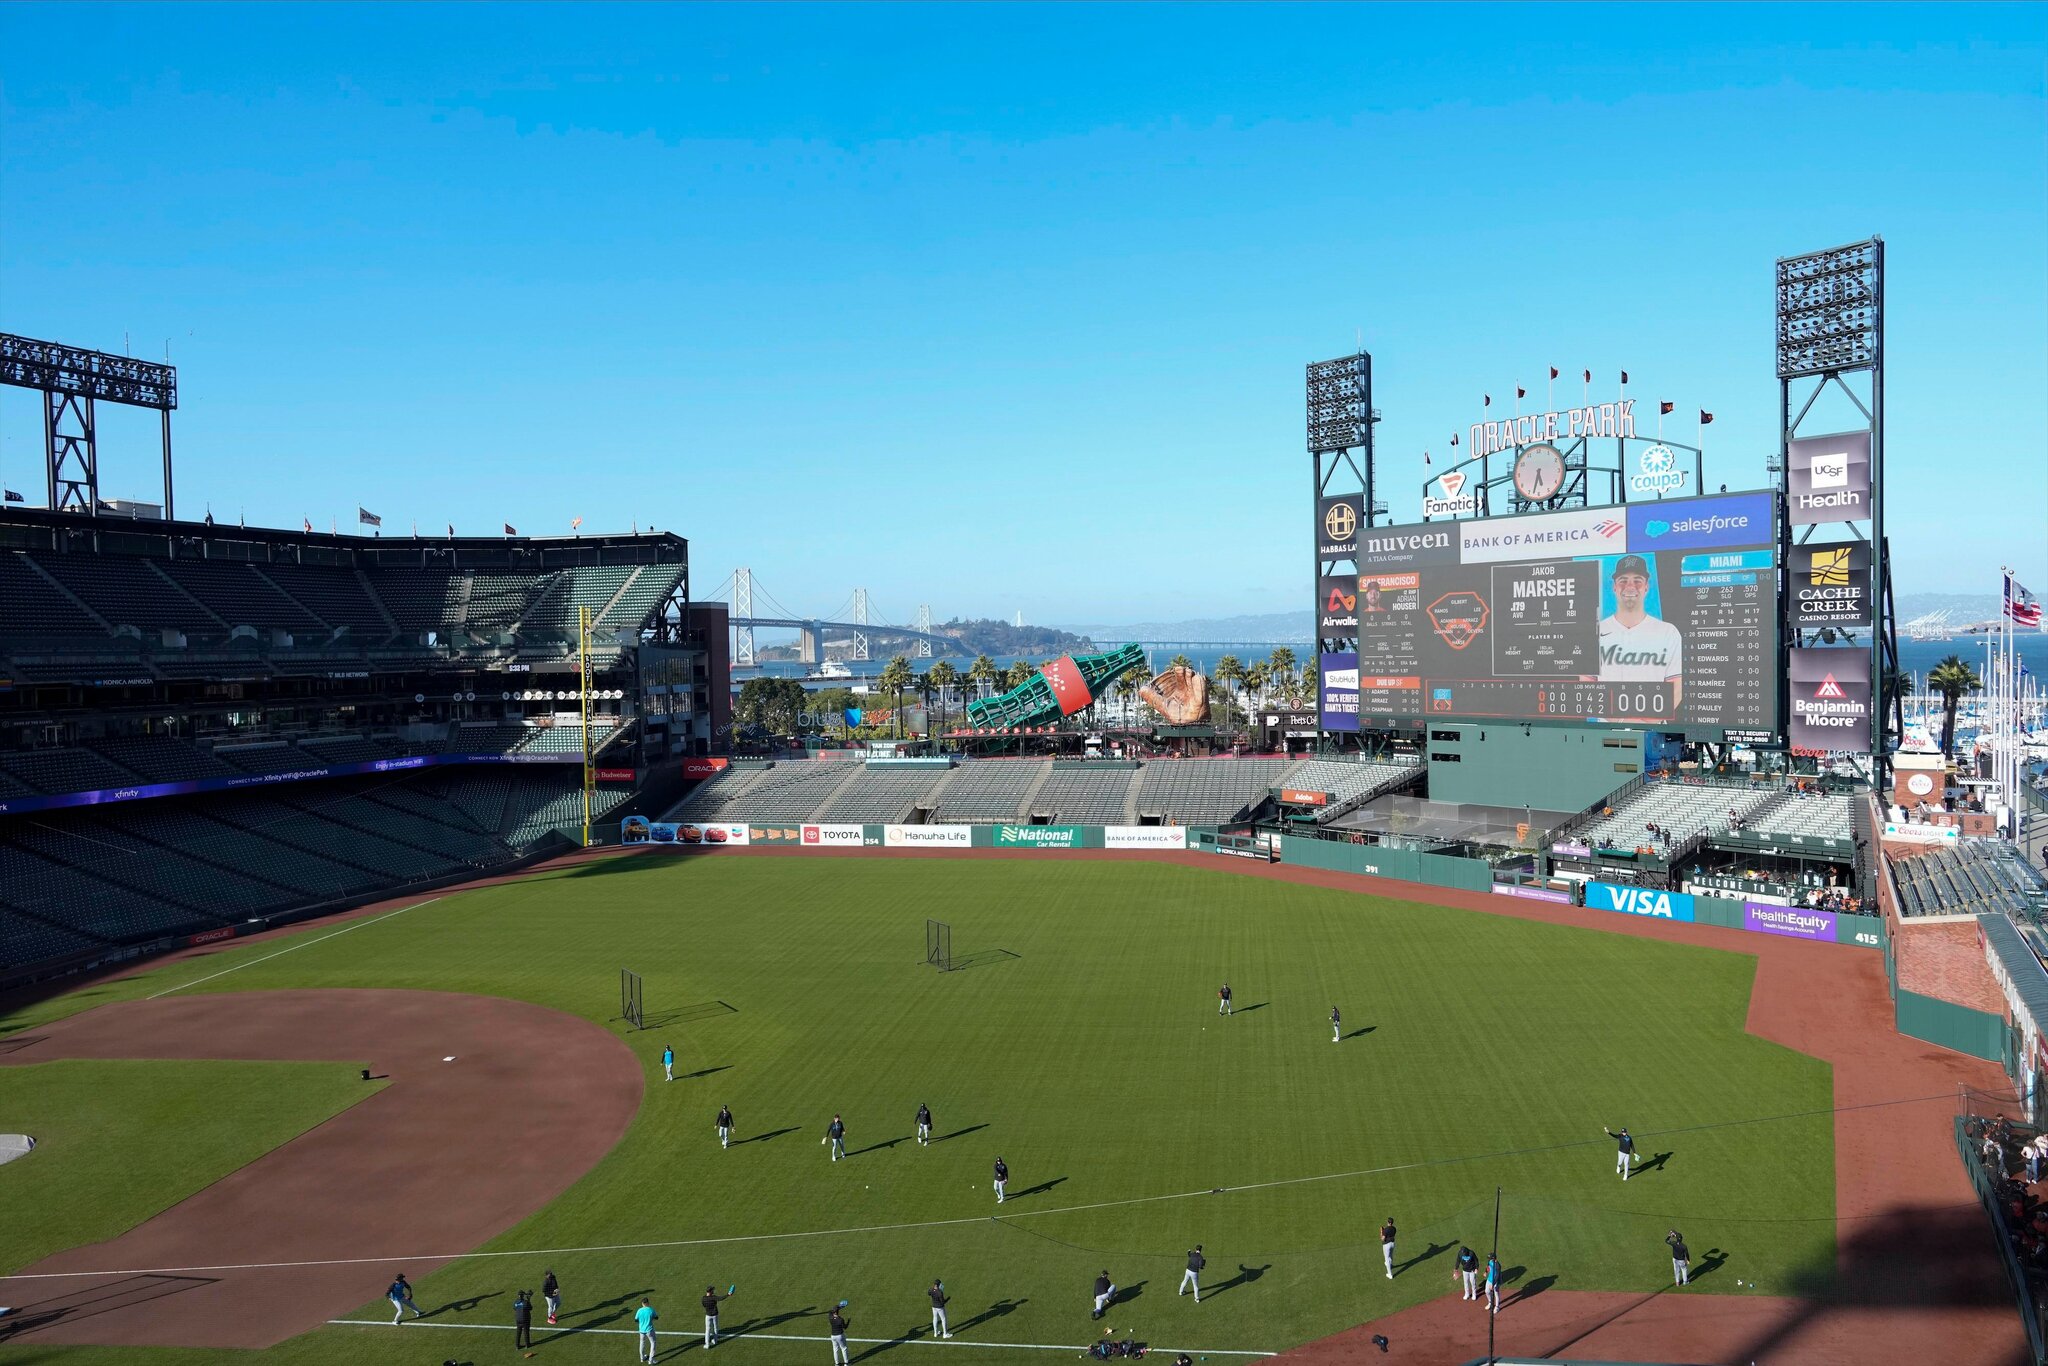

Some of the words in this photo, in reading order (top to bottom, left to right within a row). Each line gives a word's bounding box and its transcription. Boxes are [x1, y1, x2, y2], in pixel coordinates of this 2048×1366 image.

[1470, 412, 1560, 460] ORACLE
[1568, 400, 1636, 439] PARK
[1814, 464, 1844, 478] UCSF
[1635, 471, 1680, 490] coupa
[1425, 495, 1482, 514] Fanatics
[1800, 490, 1860, 509] Health
[1672, 515, 1748, 534] salesforce
[1368, 532, 1450, 553] nuveen
[1464, 536, 1500, 548] BANK
[1504, 534, 1520, 546] OF
[1524, 529, 1589, 544] AMERICA
[1320, 544, 1346, 554] HABBAS
[1710, 555, 1742, 568] MIAMI
[1532, 566, 1555, 576] JAKOB
[1377, 576, 1416, 586] FRANCISCO
[1700, 575, 1731, 583] MARSEE
[1513, 578, 1576, 598] MARSEE
[1799, 587, 1860, 600] CACHE
[1510, 602, 1525, 611] .179
[1568, 600, 1574, 609] 7
[1800, 600, 1859, 612] CREEK
[1600, 644, 1667, 666] Miami
[1329, 675, 1356, 683] StubHub
[1327, 694, 1339, 702] 100%
[1539, 691, 1545, 701] 0
[1550, 692, 1555, 701] 0
[1560, 692, 1565, 701] 0
[1576, 692, 1581, 701] 0
[1587, 693, 1593, 702] 4
[1598, 693, 1604, 702] 2
[1325, 704, 1341, 712] GIANTS
[1539, 703, 1545, 712] 0
[1550, 704, 1555, 713] 0
[1560, 704, 1565, 713] 0
[1576, 704, 1581, 713] 0
[1587, 705, 1593, 714] 4
[1598, 704, 1604, 714] 2
[1619, 694, 1628, 712] 0
[1636, 694, 1646, 712] 0
[1653, 694, 1663, 712] 0
[1796, 699, 1864, 714] Benjamin
[798, 709, 841, 726] blue
[1806, 714, 1854, 726] Moore
[1904, 734, 1926, 746] Coors
[1792, 746, 1826, 758] Coors
[389, 760, 413, 769] in-stadium
[264, 769, 329, 782] XfinityWiFi@OraclePark
[115, 790, 138, 799] xfinity
[1295, 793, 1313, 801] Adobe
[905, 832, 945, 840] Hanwha
[948, 832, 967, 841] Life
[1898, 826, 1922, 836] Coors
[1366, 865, 1378, 874] 391
[1694, 876, 1743, 890] WELCOME
[1754, 884, 1765, 893] TO
[1605, 886, 1672, 918] VISA
[1752, 908, 1828, 930] HealthEquity
[196, 931, 228, 942] ORACLE
[1856, 932, 1877, 944] 415
